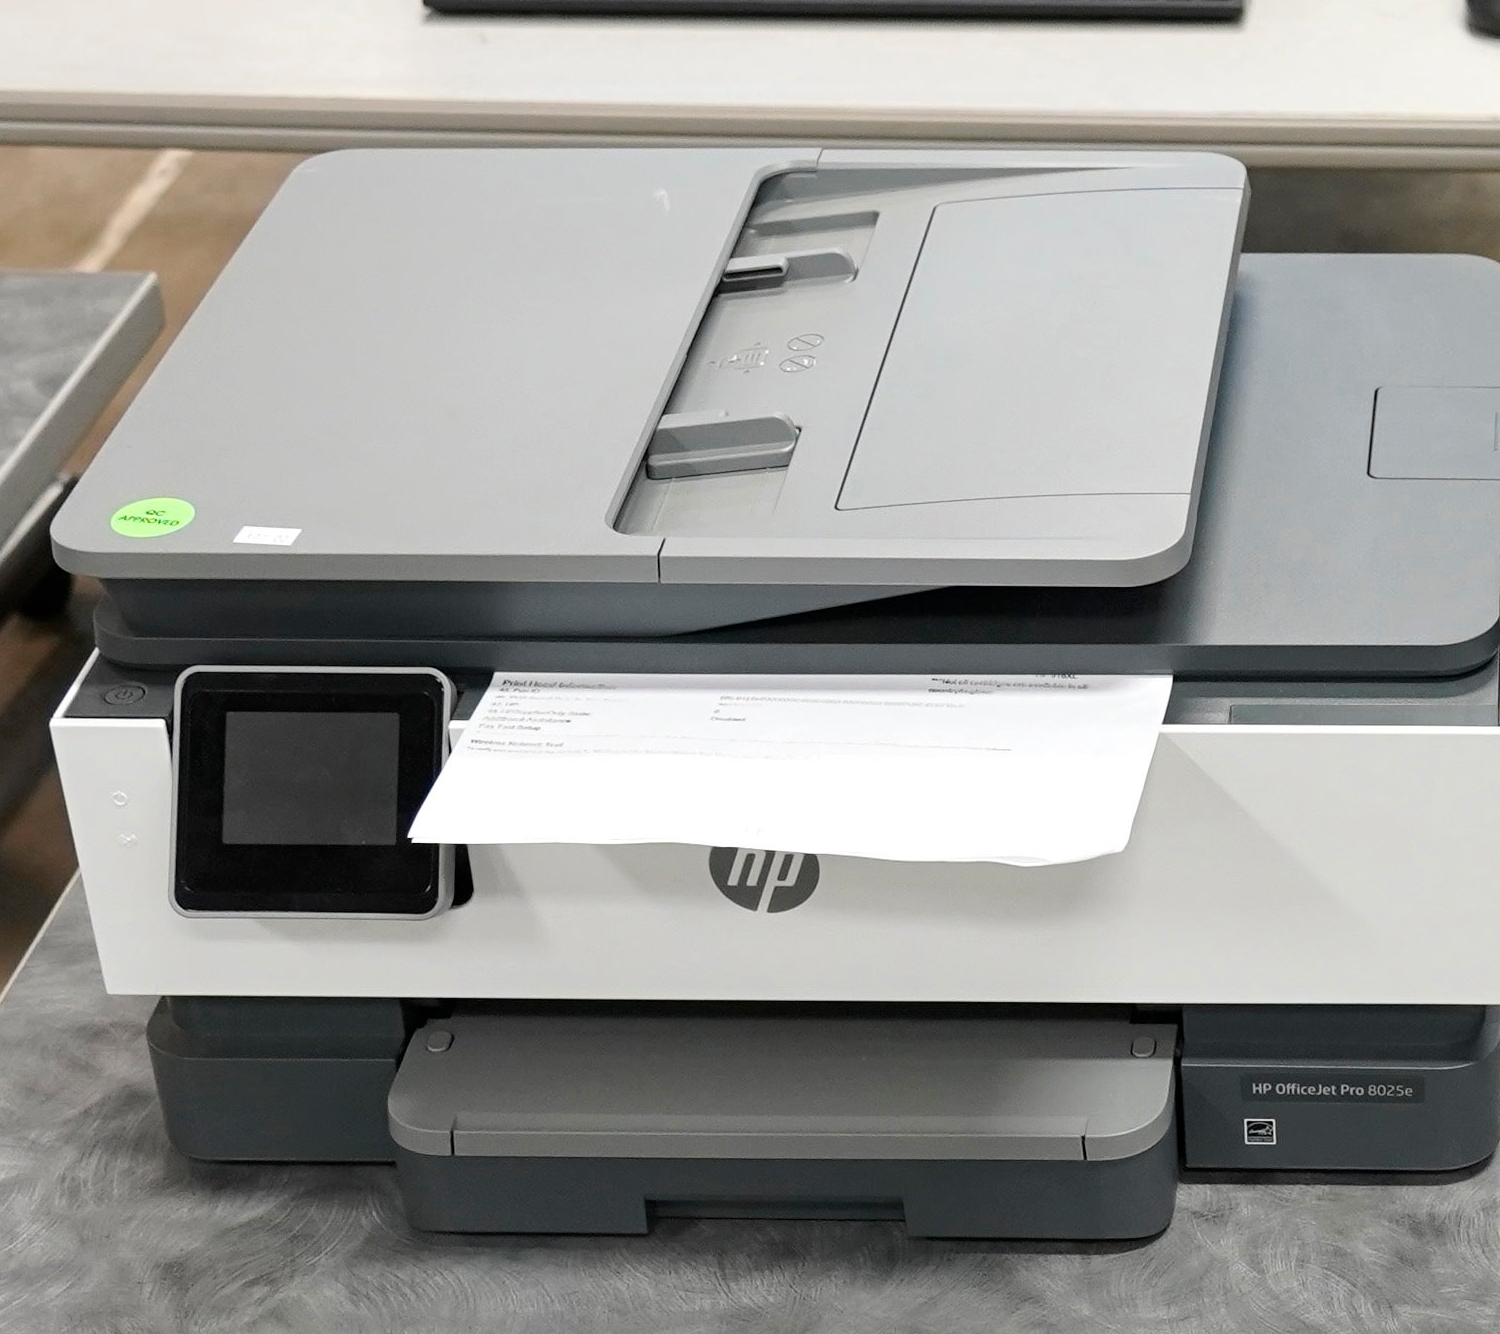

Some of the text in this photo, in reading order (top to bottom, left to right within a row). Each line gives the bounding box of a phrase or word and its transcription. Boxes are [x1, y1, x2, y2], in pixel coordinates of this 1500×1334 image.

[118, 515, 180, 527] APPROVED
[1252, 1082, 1414, 1097] HP OfficeJet Pro 8025e
